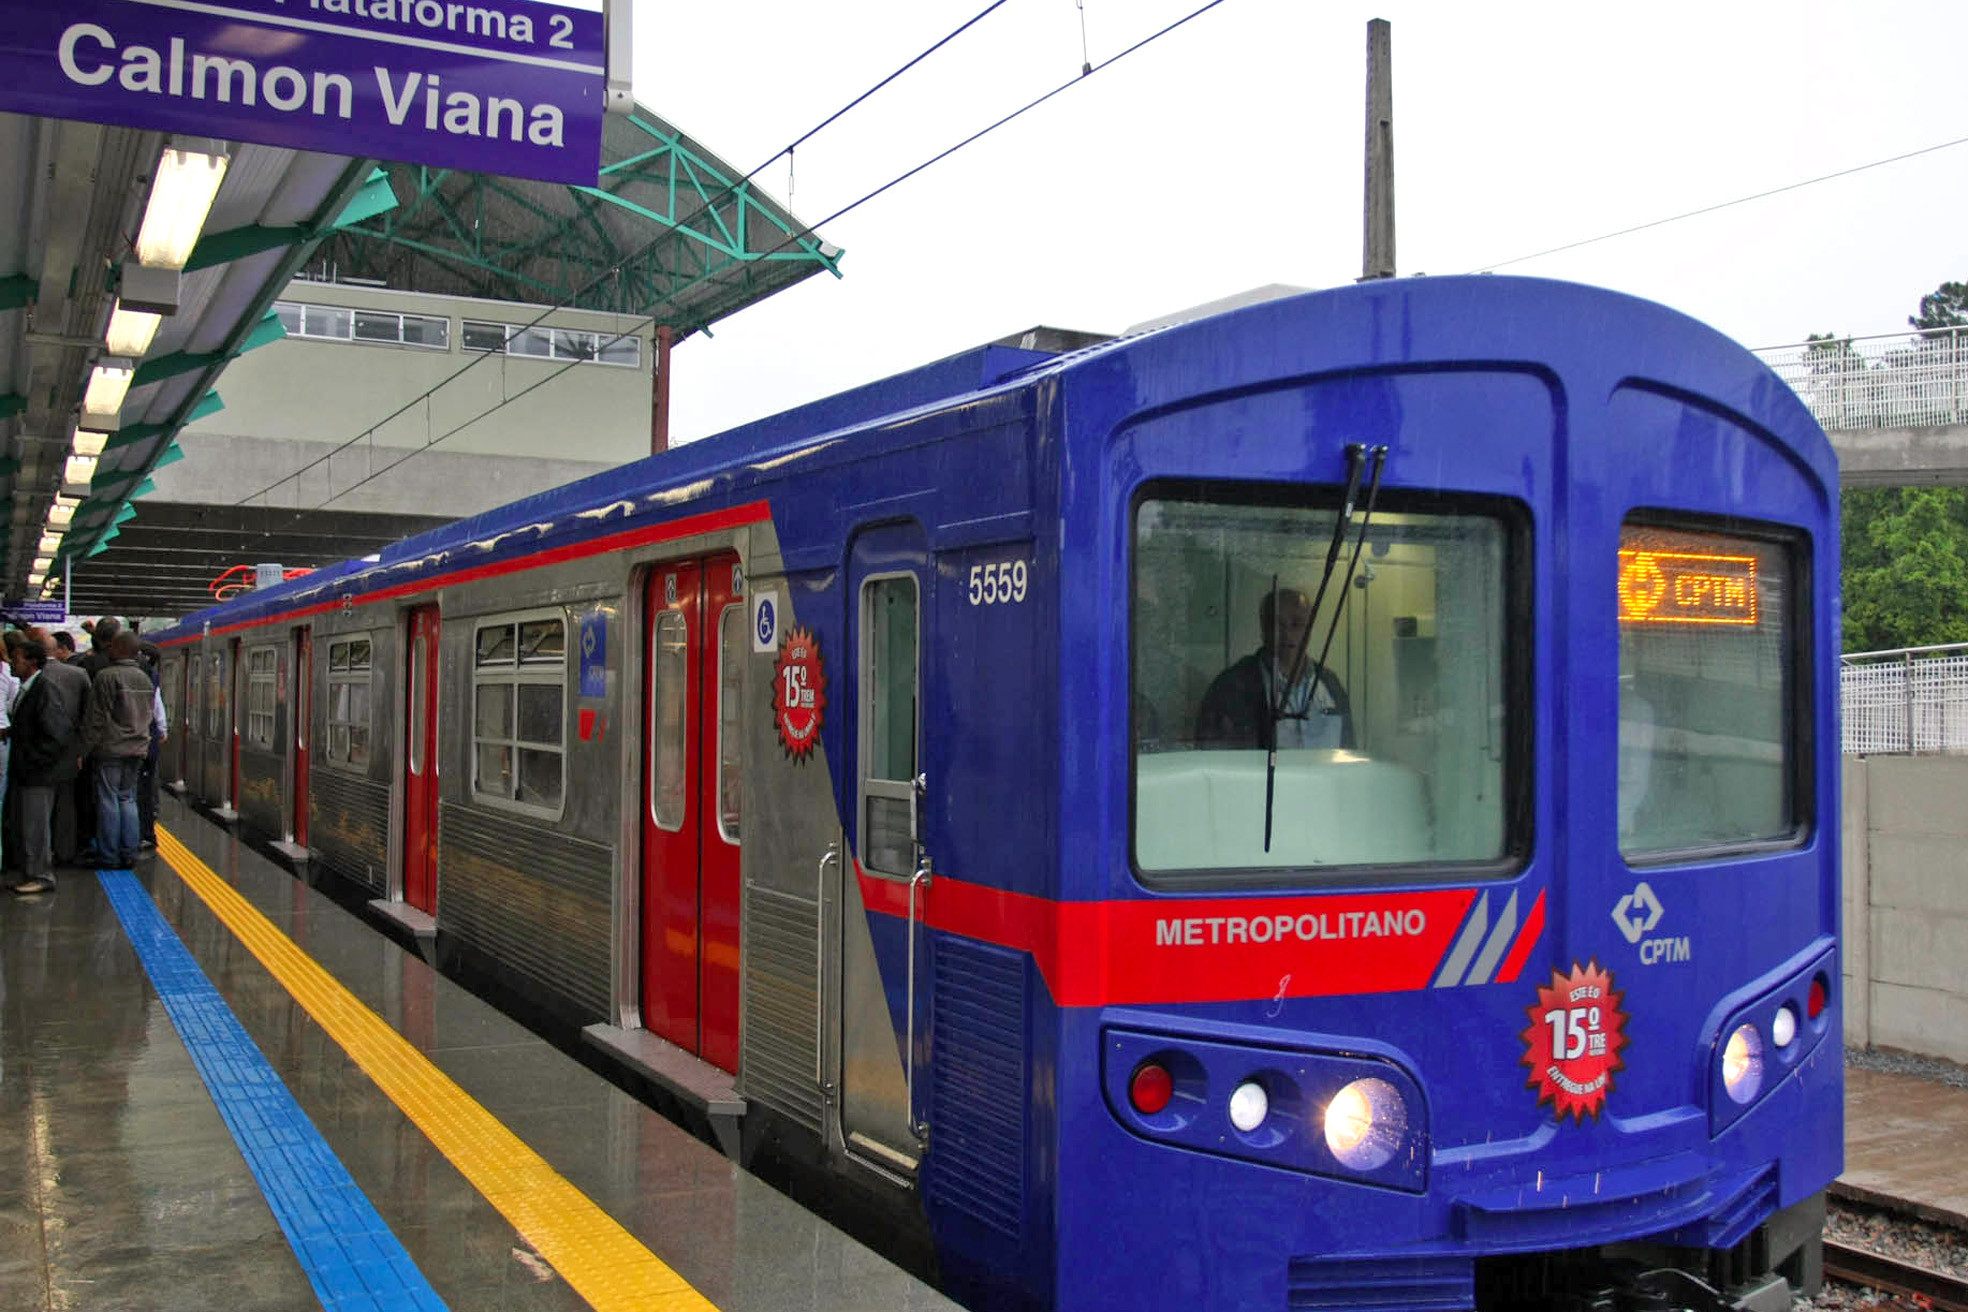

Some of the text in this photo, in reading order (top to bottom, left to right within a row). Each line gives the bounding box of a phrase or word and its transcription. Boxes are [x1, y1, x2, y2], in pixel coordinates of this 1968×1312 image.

[549, 14, 574, 49] 2
[58, 23, 565, 147] Calmon Viana
[969, 560, 1028, 605] 5559
[1675, 575, 1745, 607] CPTM
[1155, 909, 1426, 946] METROPOLITANO
[1640, 935, 1691, 965] CPTM
